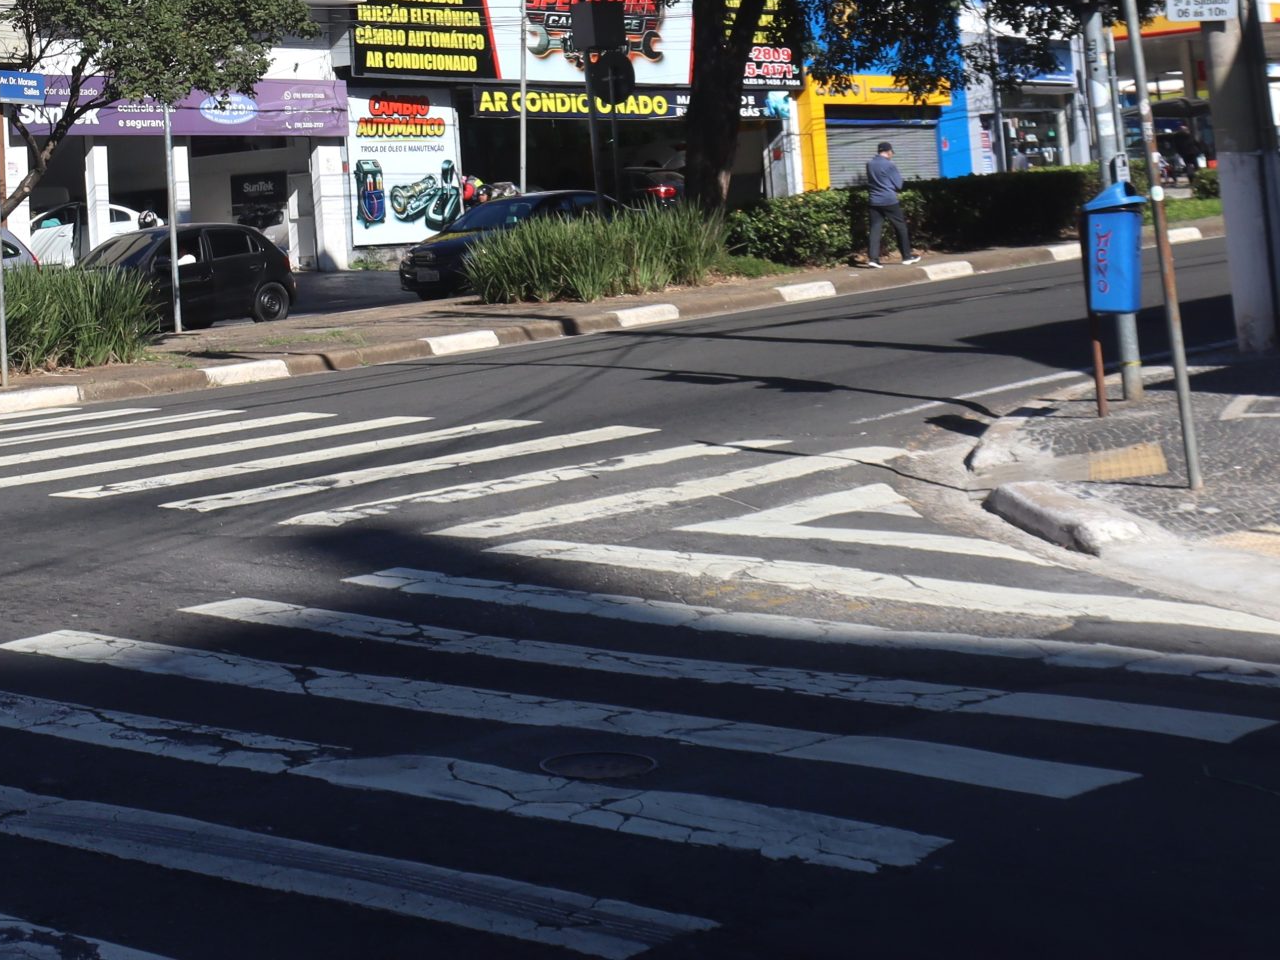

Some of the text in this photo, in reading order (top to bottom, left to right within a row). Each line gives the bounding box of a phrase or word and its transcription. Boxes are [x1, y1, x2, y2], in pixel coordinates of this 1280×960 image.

[357, 3, 481, 27] INJEÇÃO ELETRÔNICA
[355, 25, 485, 51] CÂMBIO AUTOMÁTICO
[366, 51, 478, 72] AR CONDICIONADO
[0, 77, 37, 87] Av. Dr. Moraes
[117, 103, 176, 113] controle soar
[368, 90, 430, 116] CÂMBIO
[479, 91, 508, 112] AR
[19, 101, 100, 125] Sunek
[126, 119, 171, 130] seguranç
[356, 114, 445, 137] AUTOMÁTICO
[361, 145, 378, 153] TROCA
[388, 143, 402, 153] ÓLEO
[408, 145, 445, 153] MANUTENÇÃO
[243, 181, 274, 193] SunTek
